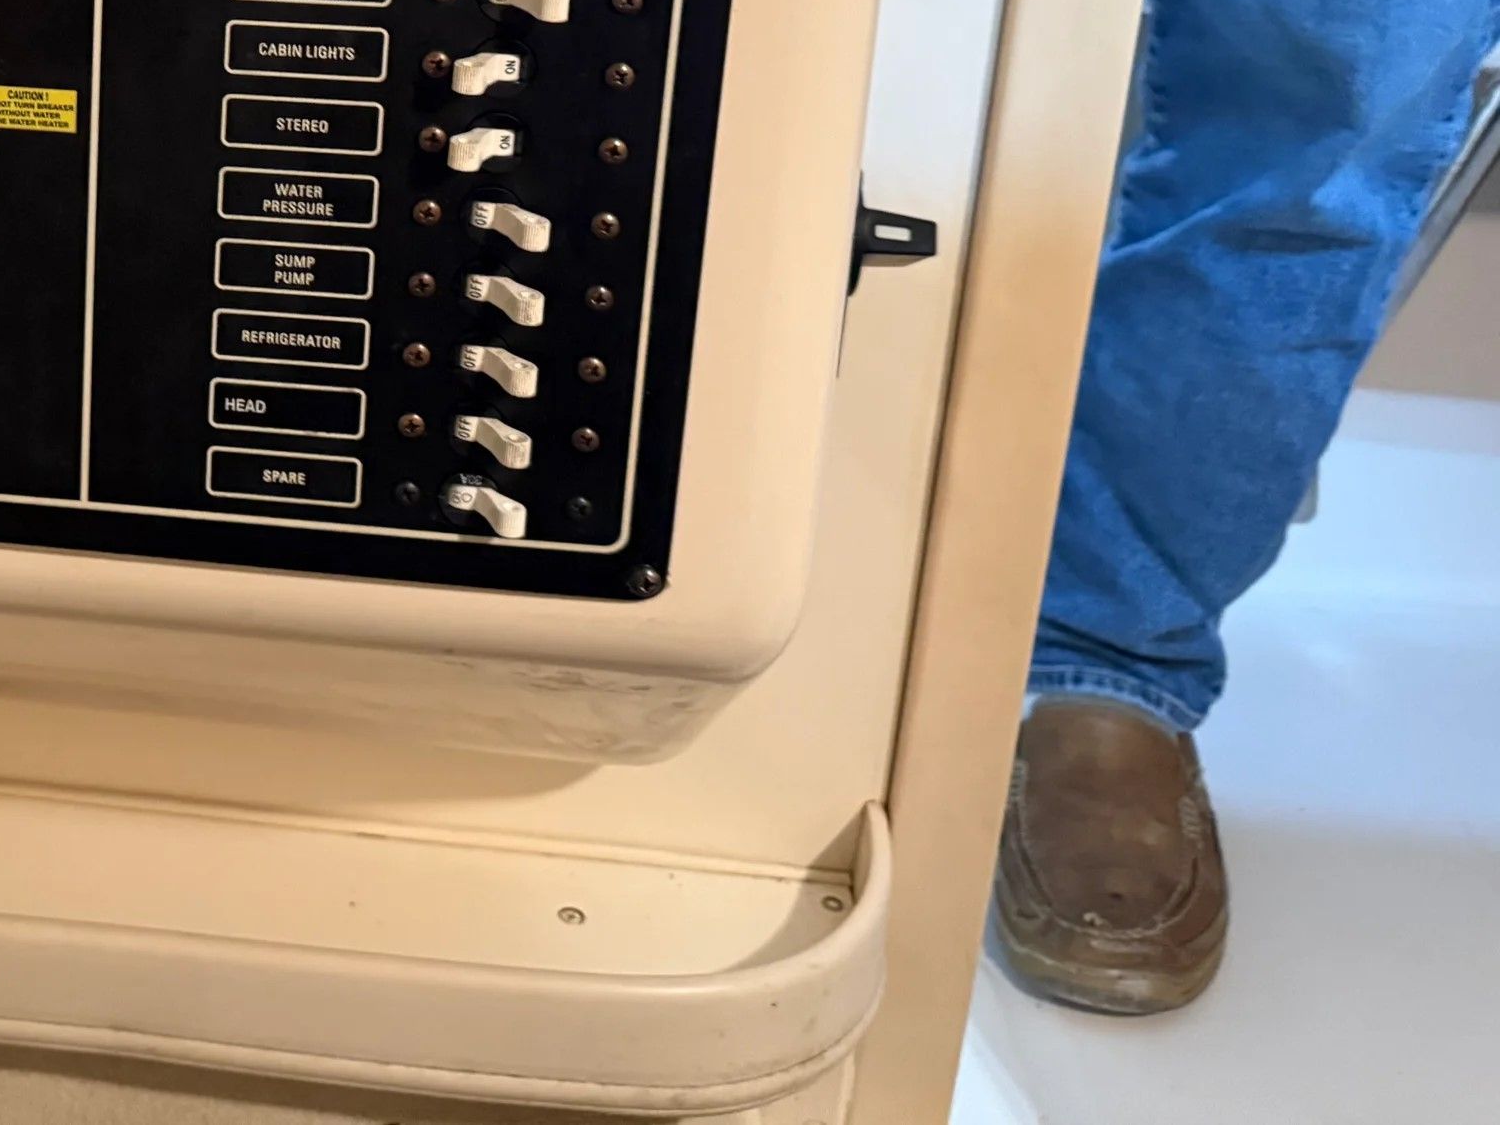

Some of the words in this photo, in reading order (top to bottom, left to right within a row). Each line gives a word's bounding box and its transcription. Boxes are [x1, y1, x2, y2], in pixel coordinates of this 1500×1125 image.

[258, 42, 302, 58] CABIN
[306, 44, 355, 61] LIGHTS
[505, 60, 516, 74] ON
[7, 89, 44, 101] CAUTION
[14, 101, 35, 109] TURN
[37, 102, 74, 111] BREAKER
[9, 118, 36, 126] WATER
[38, 120, 69, 128] HEATER
[33, 111, 61, 119] WATER
[276, 117, 329, 134] STEREO
[500, 135, 510, 150] ON
[274, 183, 323, 199] WATER
[263, 199, 334, 216] PRESSURE
[475, 204, 491, 226] OFF
[274, 253, 316, 269] SUMP
[274, 271, 314, 286] PUMP
[469, 278, 485, 299] OFF
[241, 329, 341, 350] REFRIGERATOR
[464, 347, 480, 368] OFF
[224, 398, 266, 414] HEAD
[458, 418, 473, 439] OFF
[262, 469, 307, 486] SPARE
